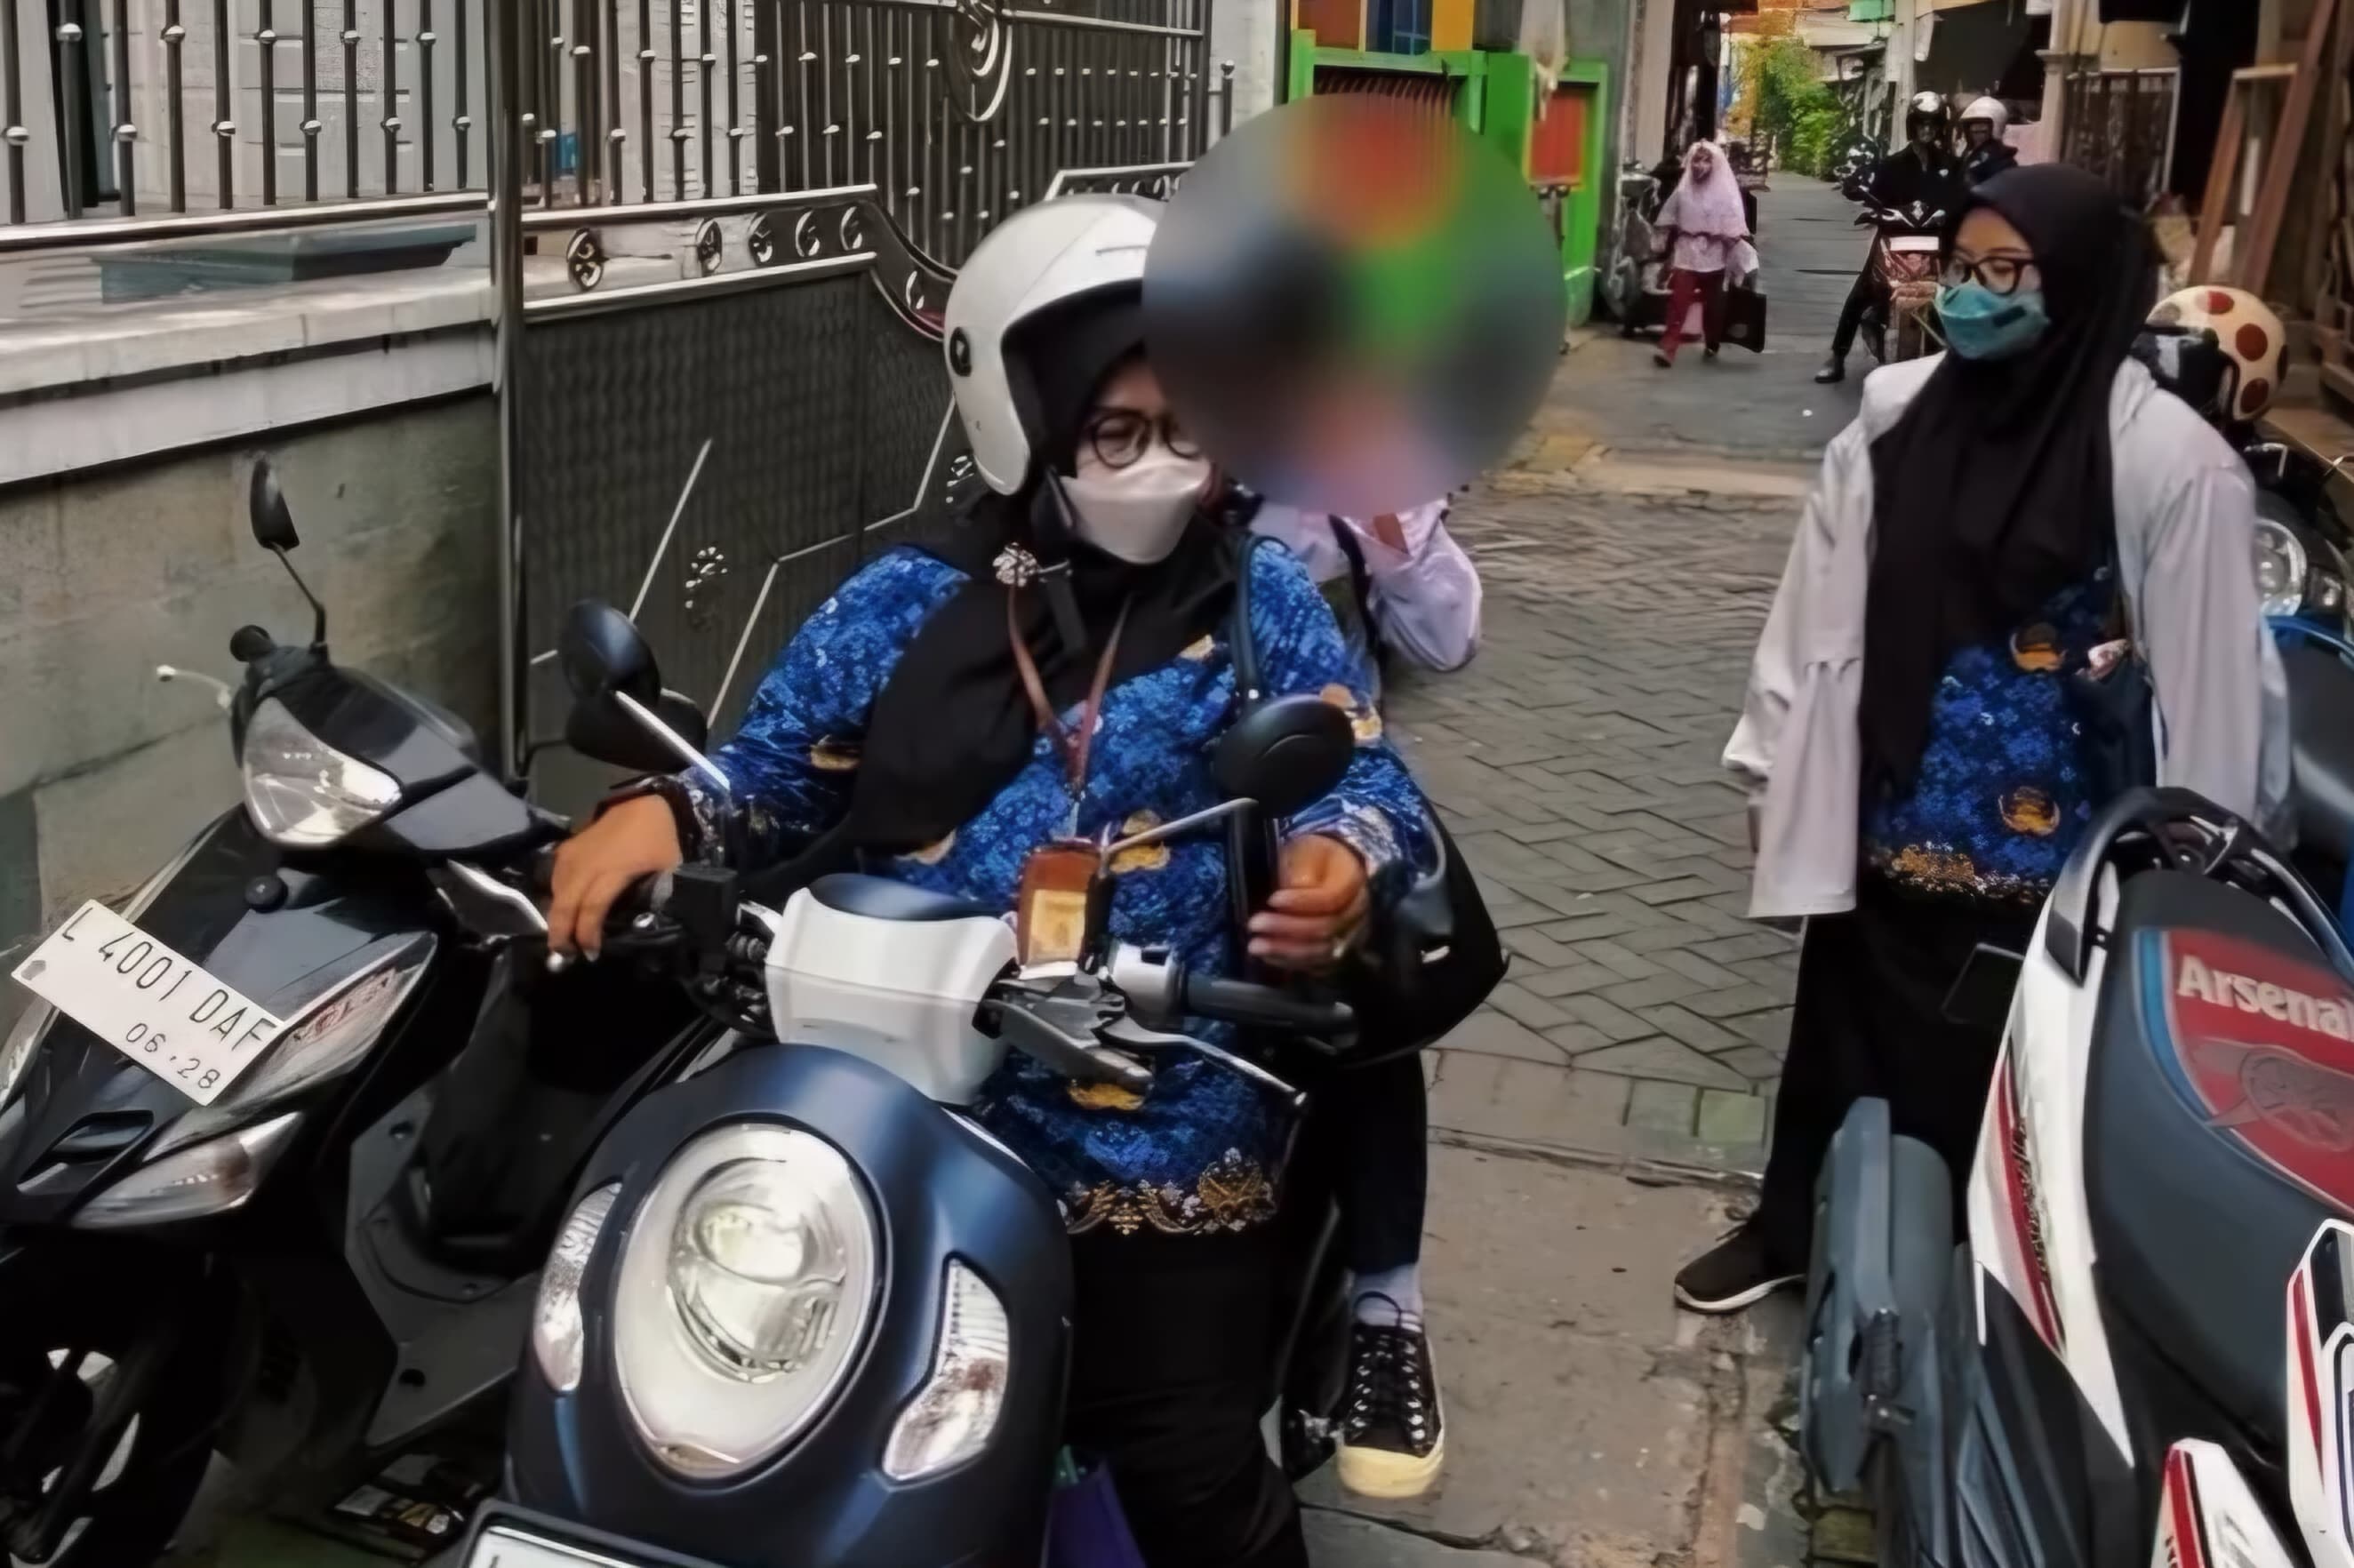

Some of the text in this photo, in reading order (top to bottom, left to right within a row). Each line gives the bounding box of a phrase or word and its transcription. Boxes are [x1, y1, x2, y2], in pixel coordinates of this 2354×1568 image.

[61, 907, 277, 1052] L 4001 DAF
